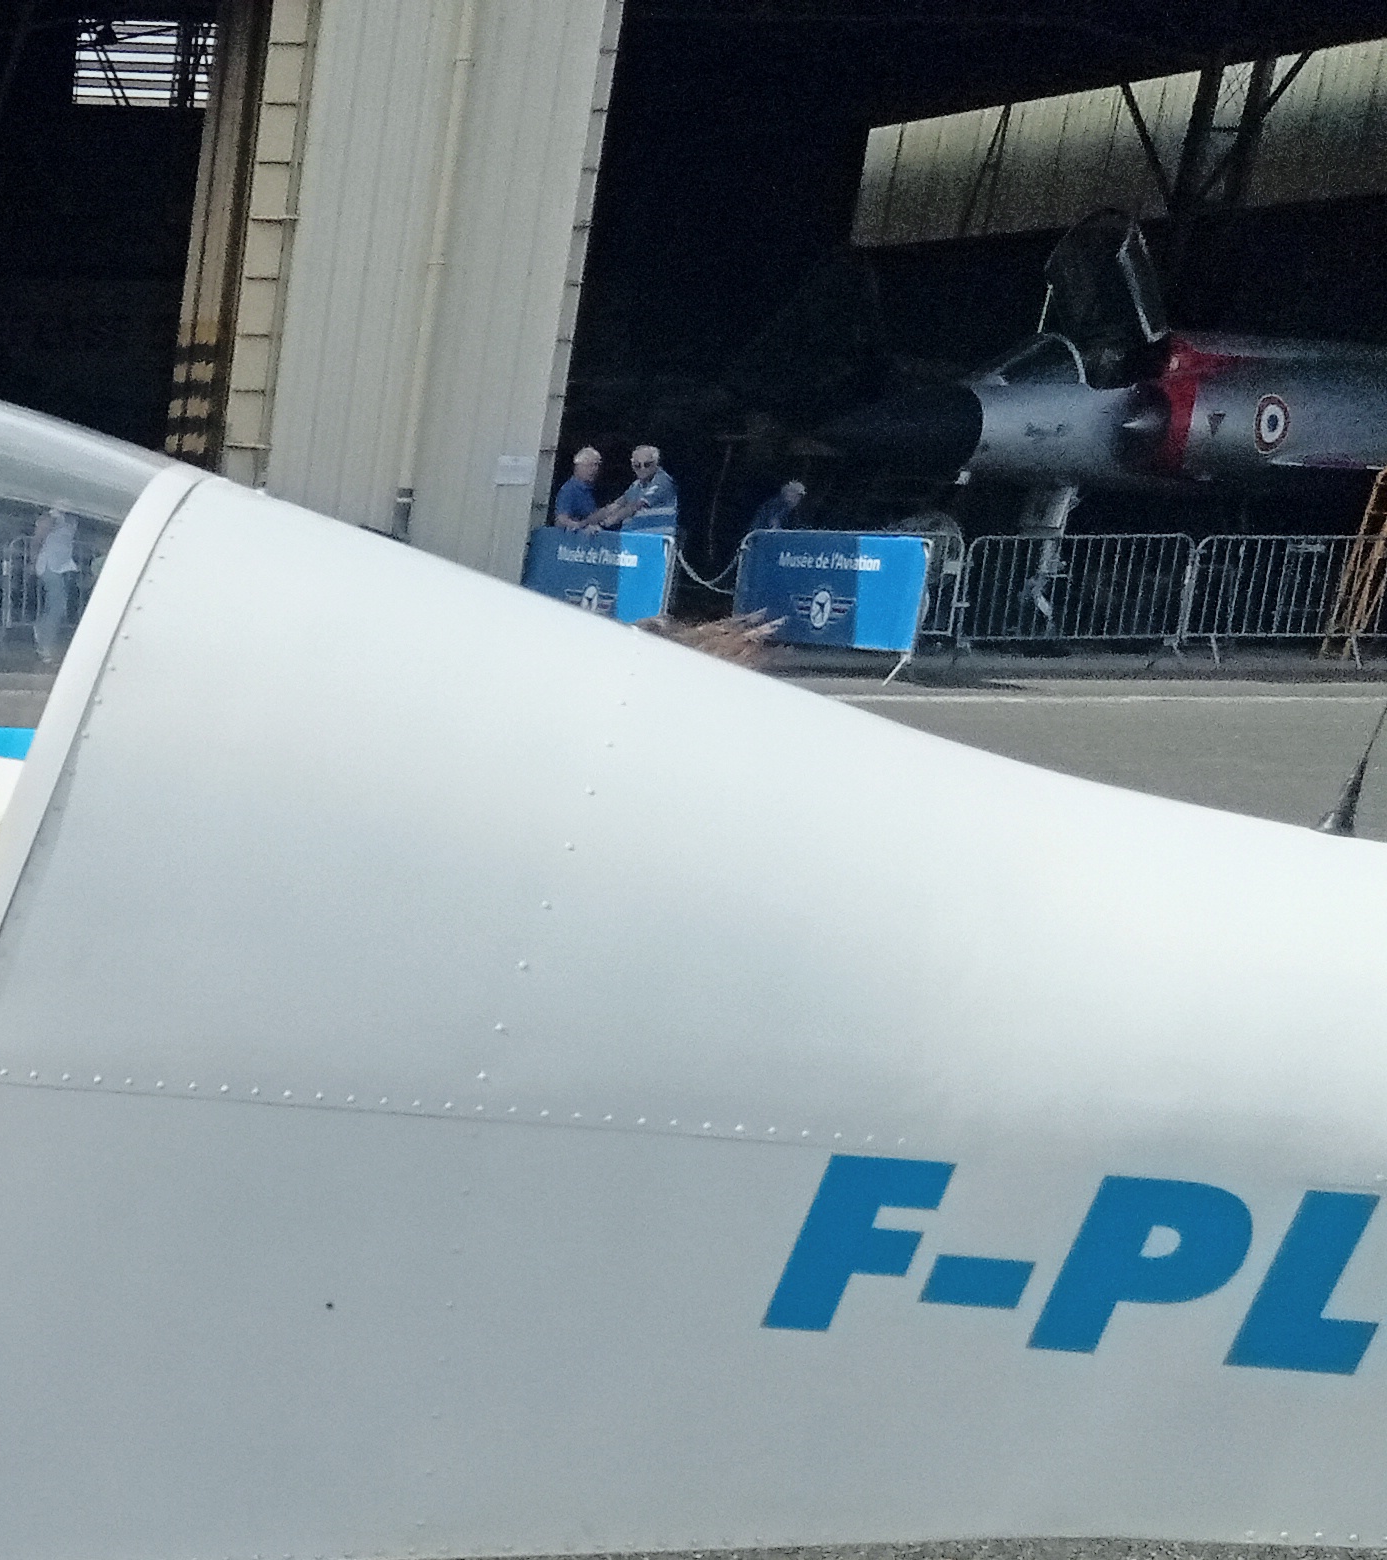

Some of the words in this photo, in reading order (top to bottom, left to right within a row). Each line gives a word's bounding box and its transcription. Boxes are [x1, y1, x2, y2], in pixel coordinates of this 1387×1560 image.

[779, 551, 814, 568] Musée
[815, 552, 829, 569] de
[830, 550, 880, 571] l'Aviation
[760, 1153, 1381, 1376] F-PL
